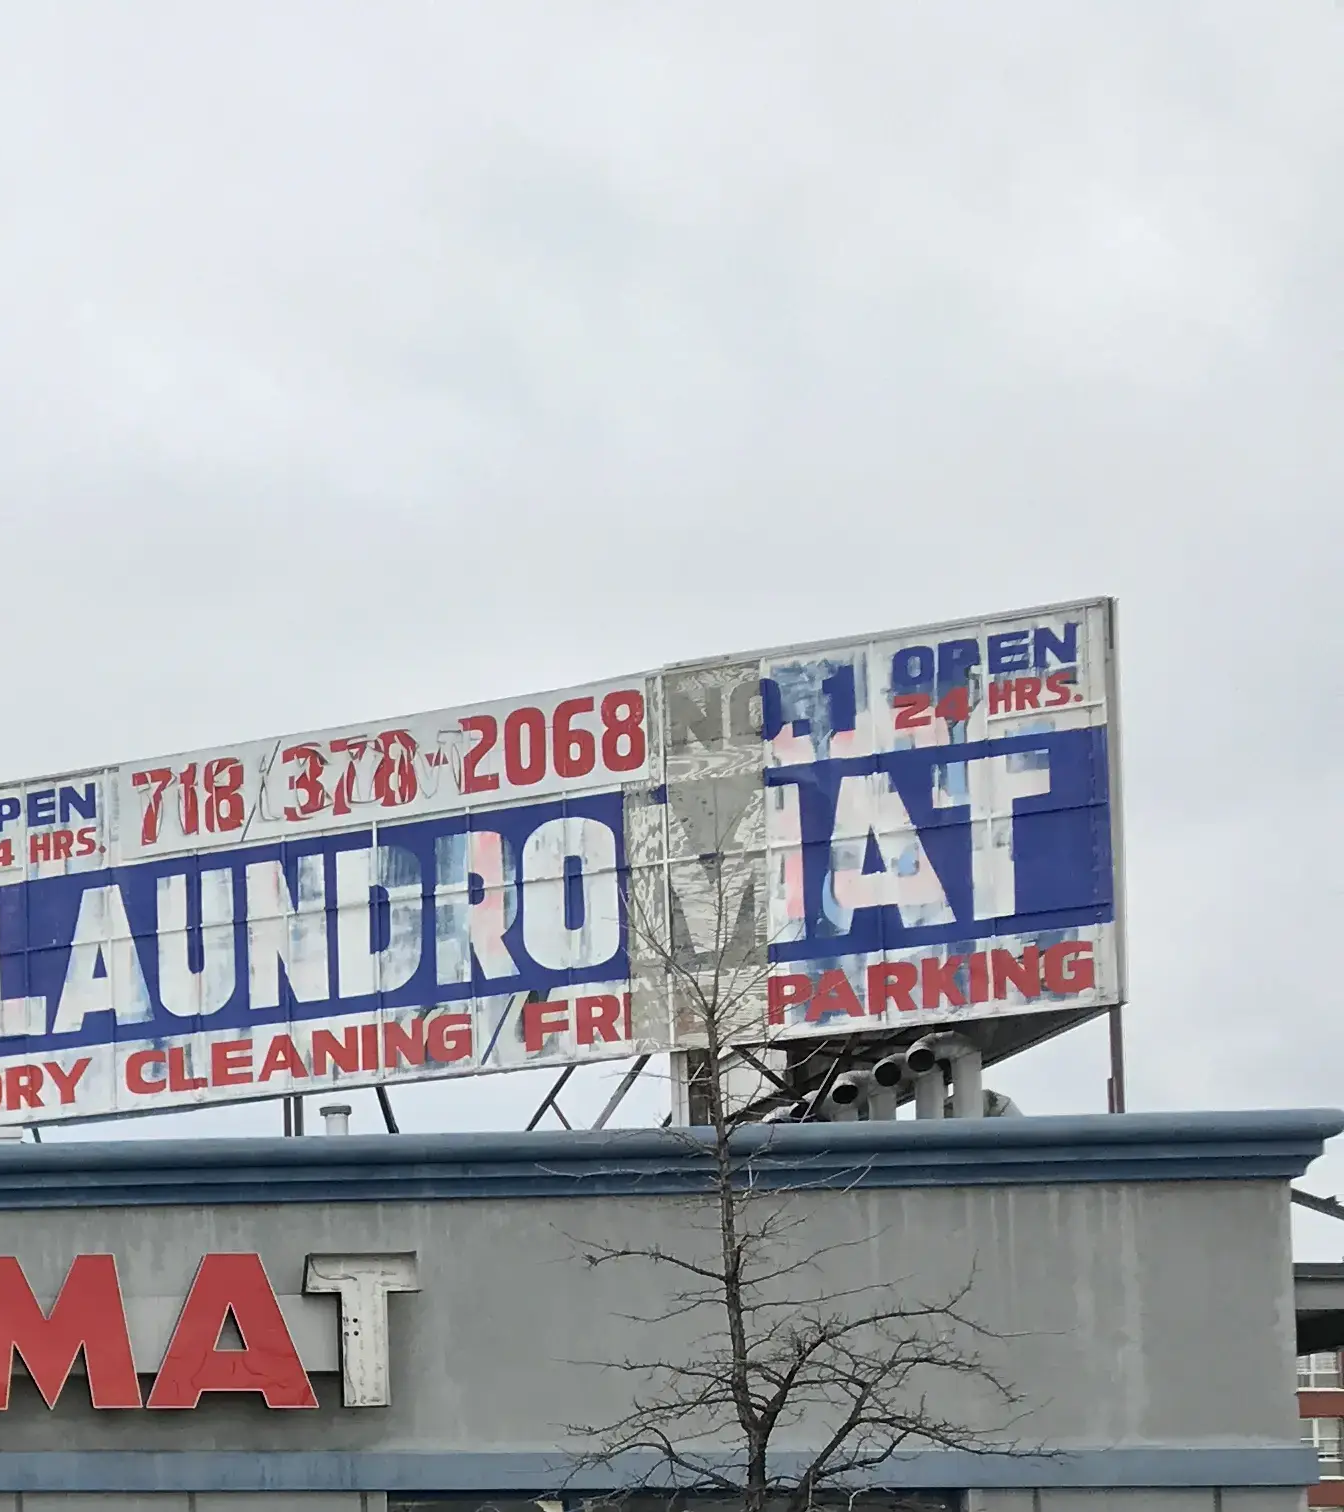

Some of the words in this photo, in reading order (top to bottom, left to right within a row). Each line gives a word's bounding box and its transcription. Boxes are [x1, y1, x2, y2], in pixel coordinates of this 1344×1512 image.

[891, 622, 1078, 686] OPEN
[666, 664, 856, 752] NO.1
[894, 687, 972, 730] 24
[988, 672, 1084, 715] HRS.
[29, 826, 107, 864] HRS.
[125, 1013, 473, 1095] CLEANING
[768, 940, 1096, 1026] PARKING
